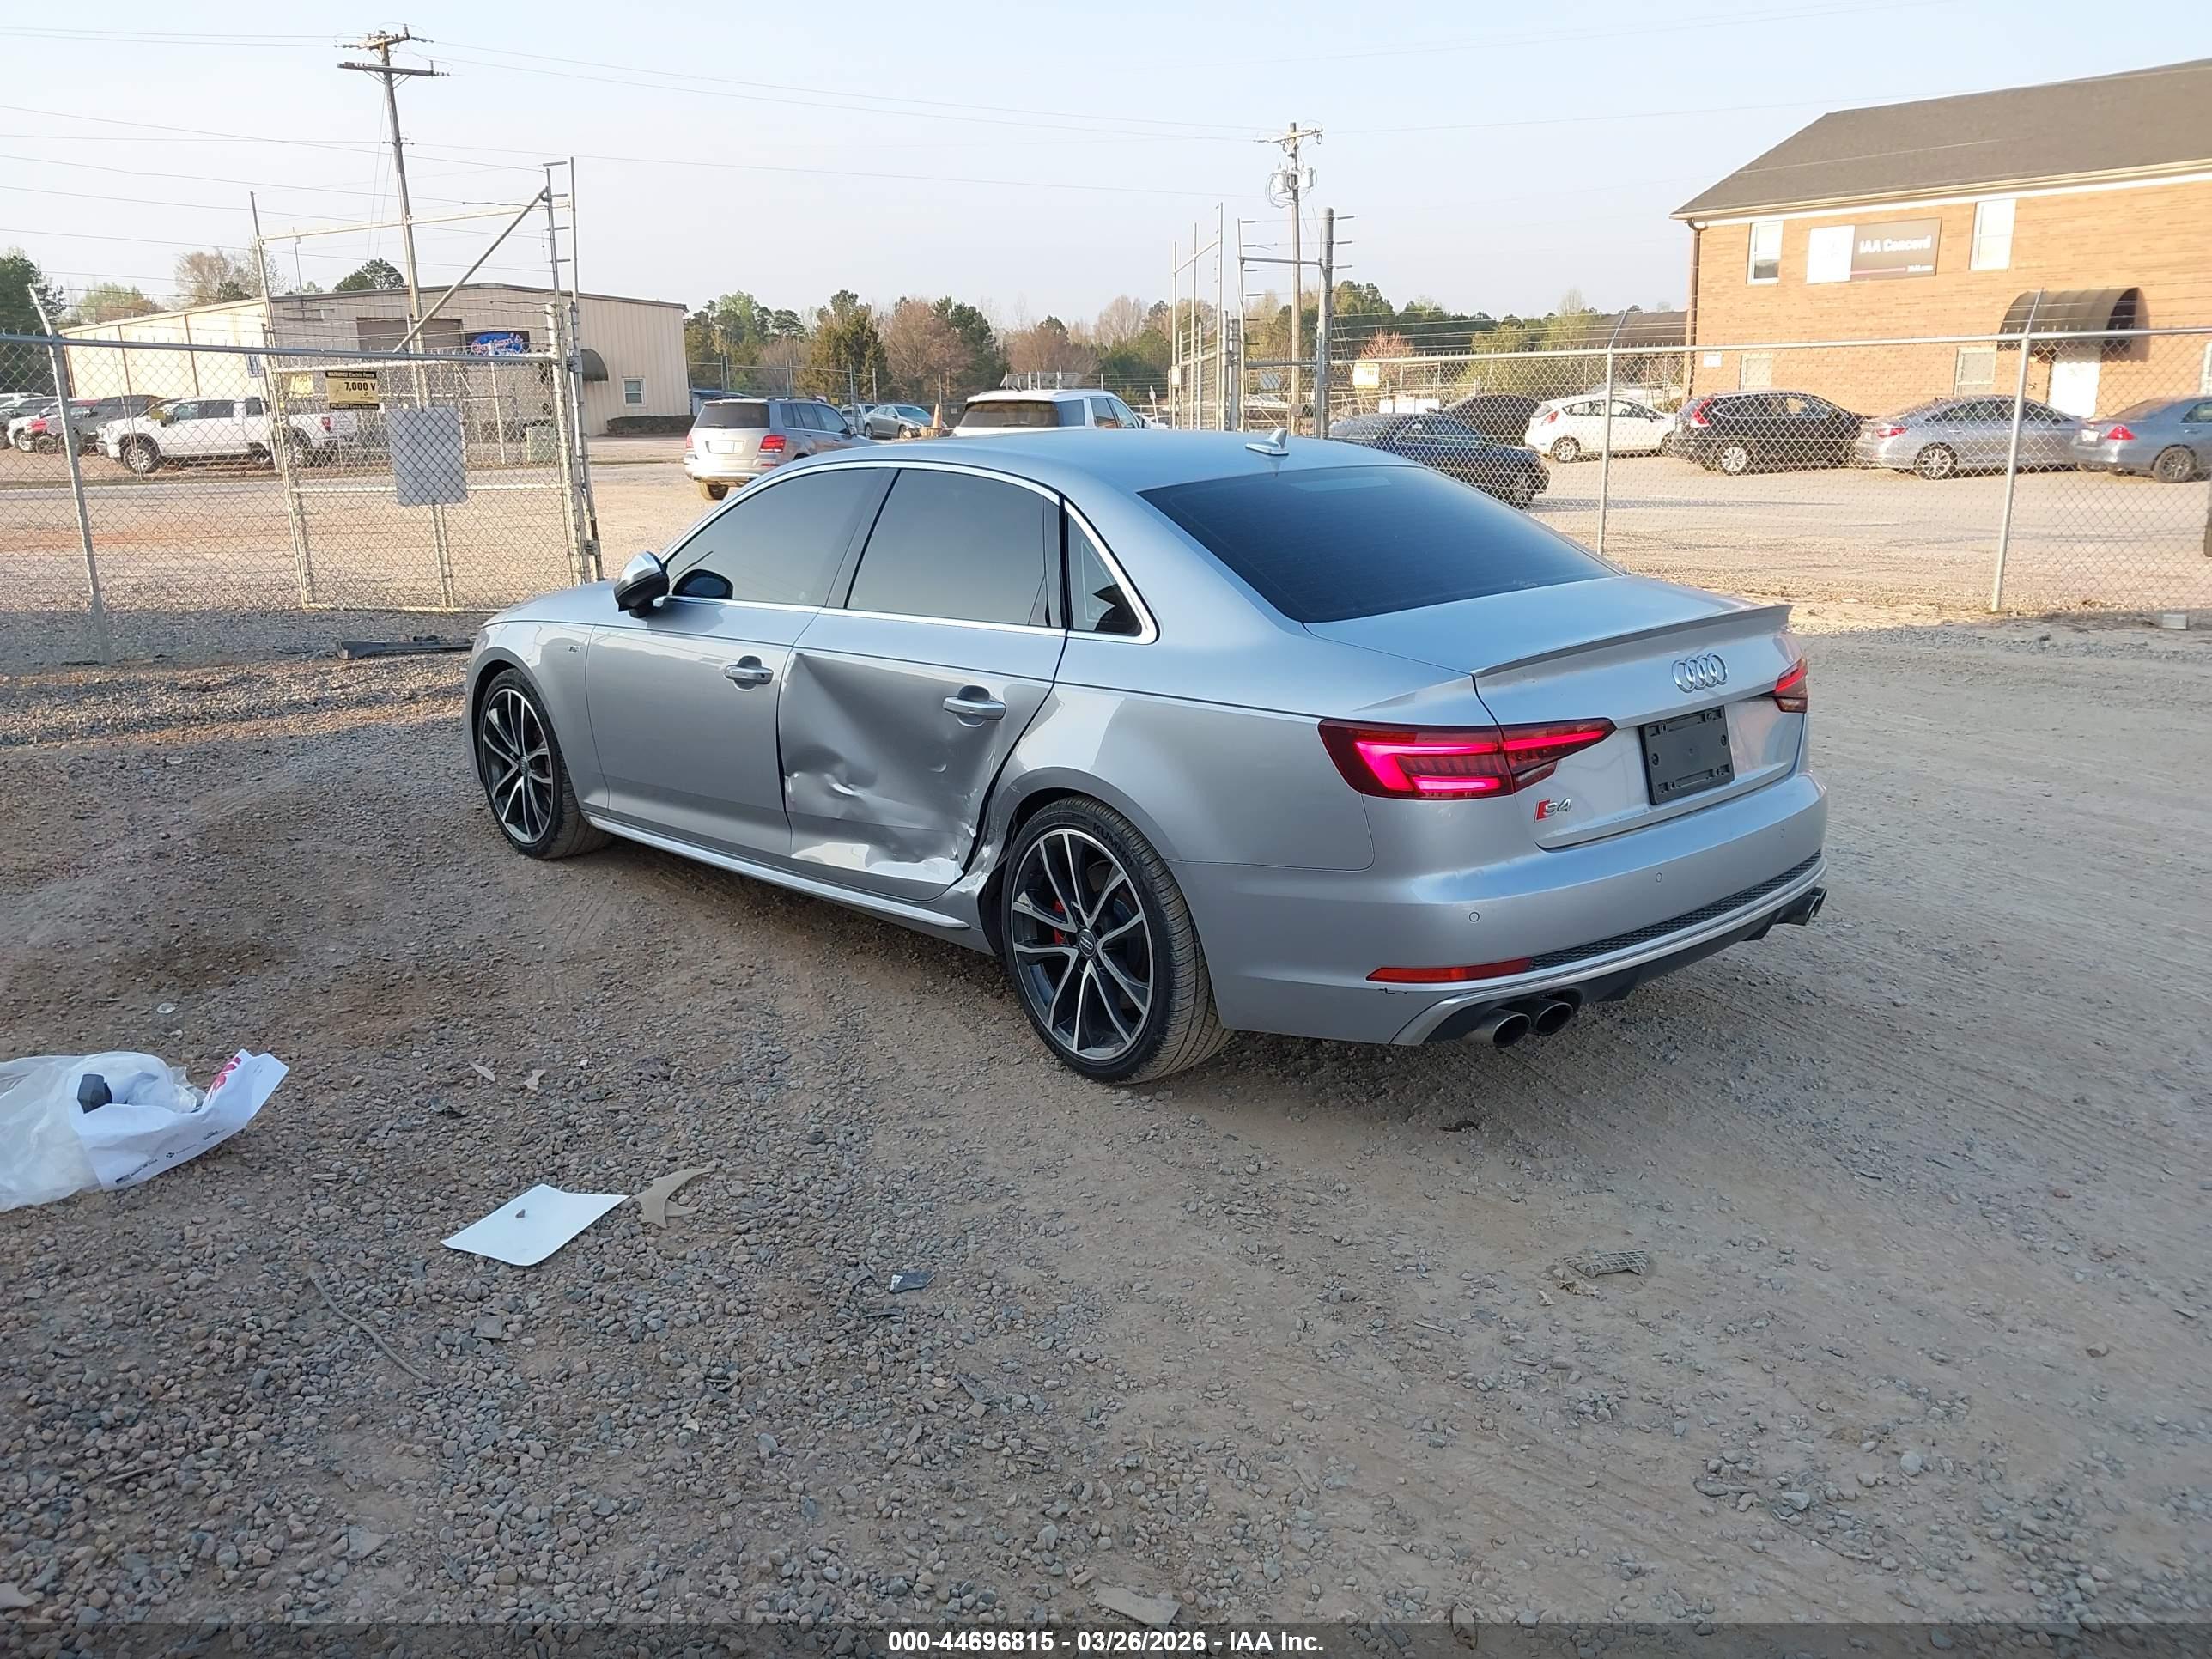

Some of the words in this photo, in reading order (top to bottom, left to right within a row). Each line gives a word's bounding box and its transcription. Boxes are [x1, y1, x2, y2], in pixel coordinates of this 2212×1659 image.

[1859, 239, 1881, 254] IAA
[344, 381, 369, 392] 7,000
[370, 382, 376, 392] V
[1542, 797, 1572, 817] S4
